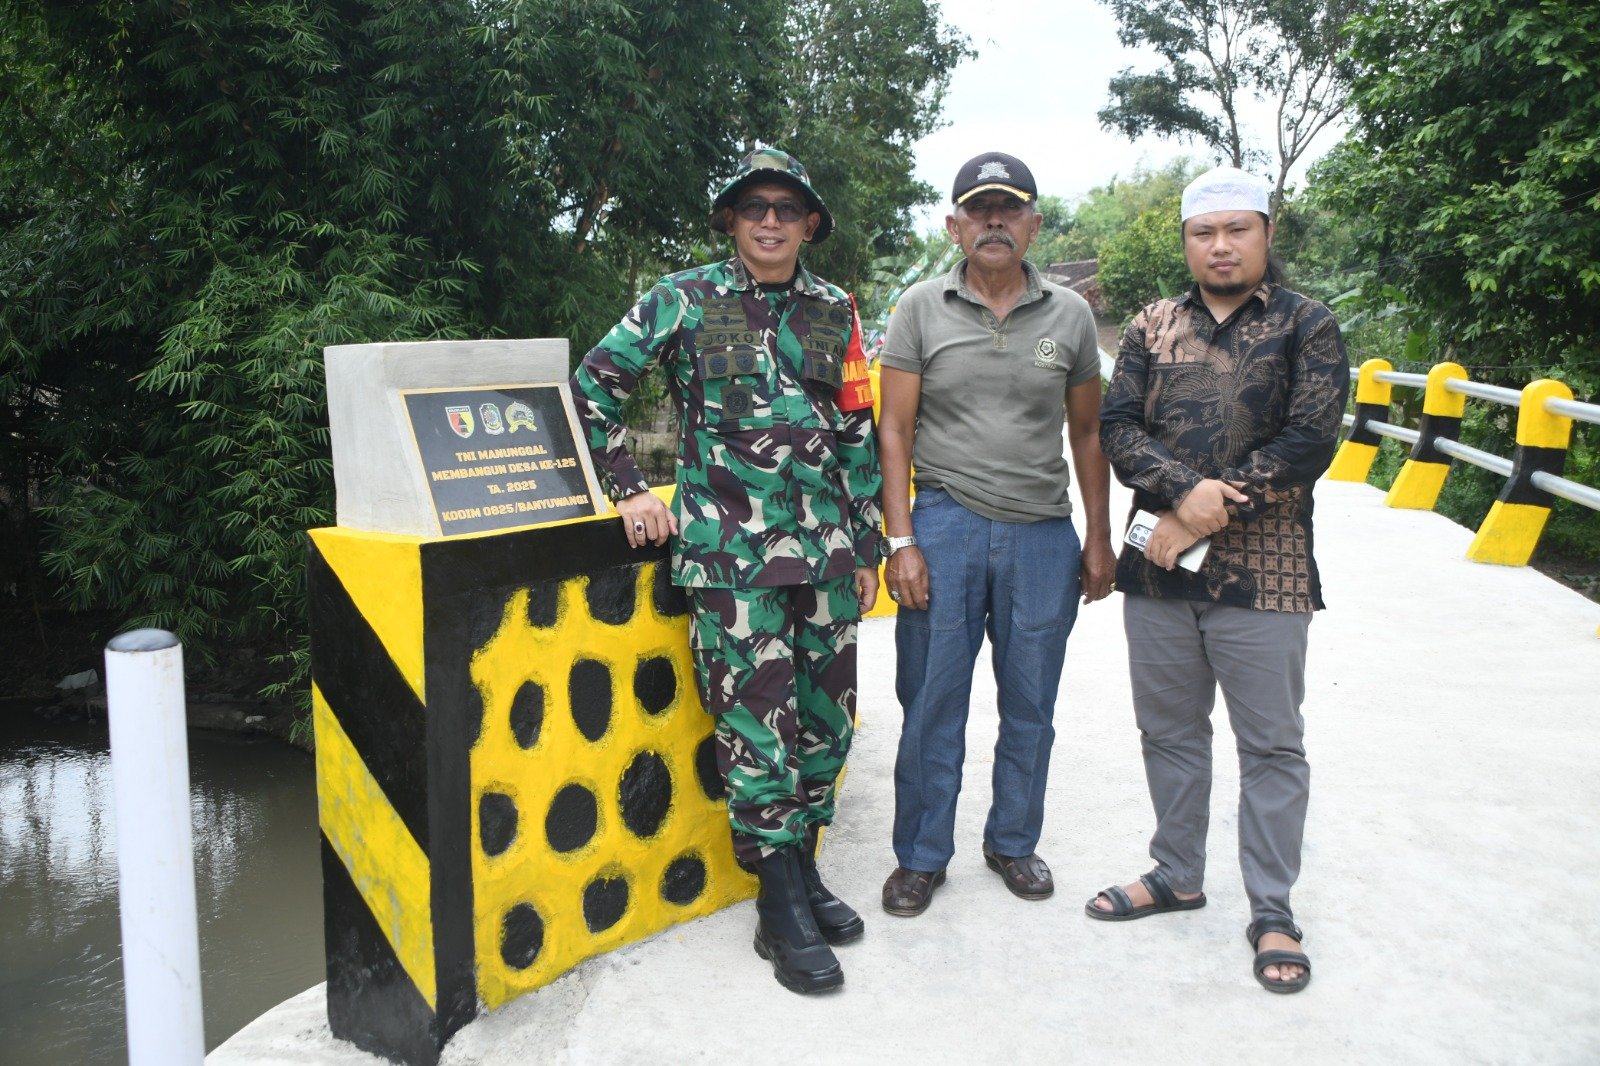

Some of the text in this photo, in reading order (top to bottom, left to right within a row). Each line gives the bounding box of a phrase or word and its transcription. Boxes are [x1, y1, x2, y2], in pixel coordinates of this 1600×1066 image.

[703, 333, 754, 345] JOKO
[808, 339, 828, 351] TNI
[455, 445, 547, 462] TNI MANUNGGAL
[432, 457, 577, 480] MEMBANGUN DESA KE-125
[487, 479, 537, 495] TA. 2025
[442, 495, 588, 522] KODIM 0825/BANYUWANGI
